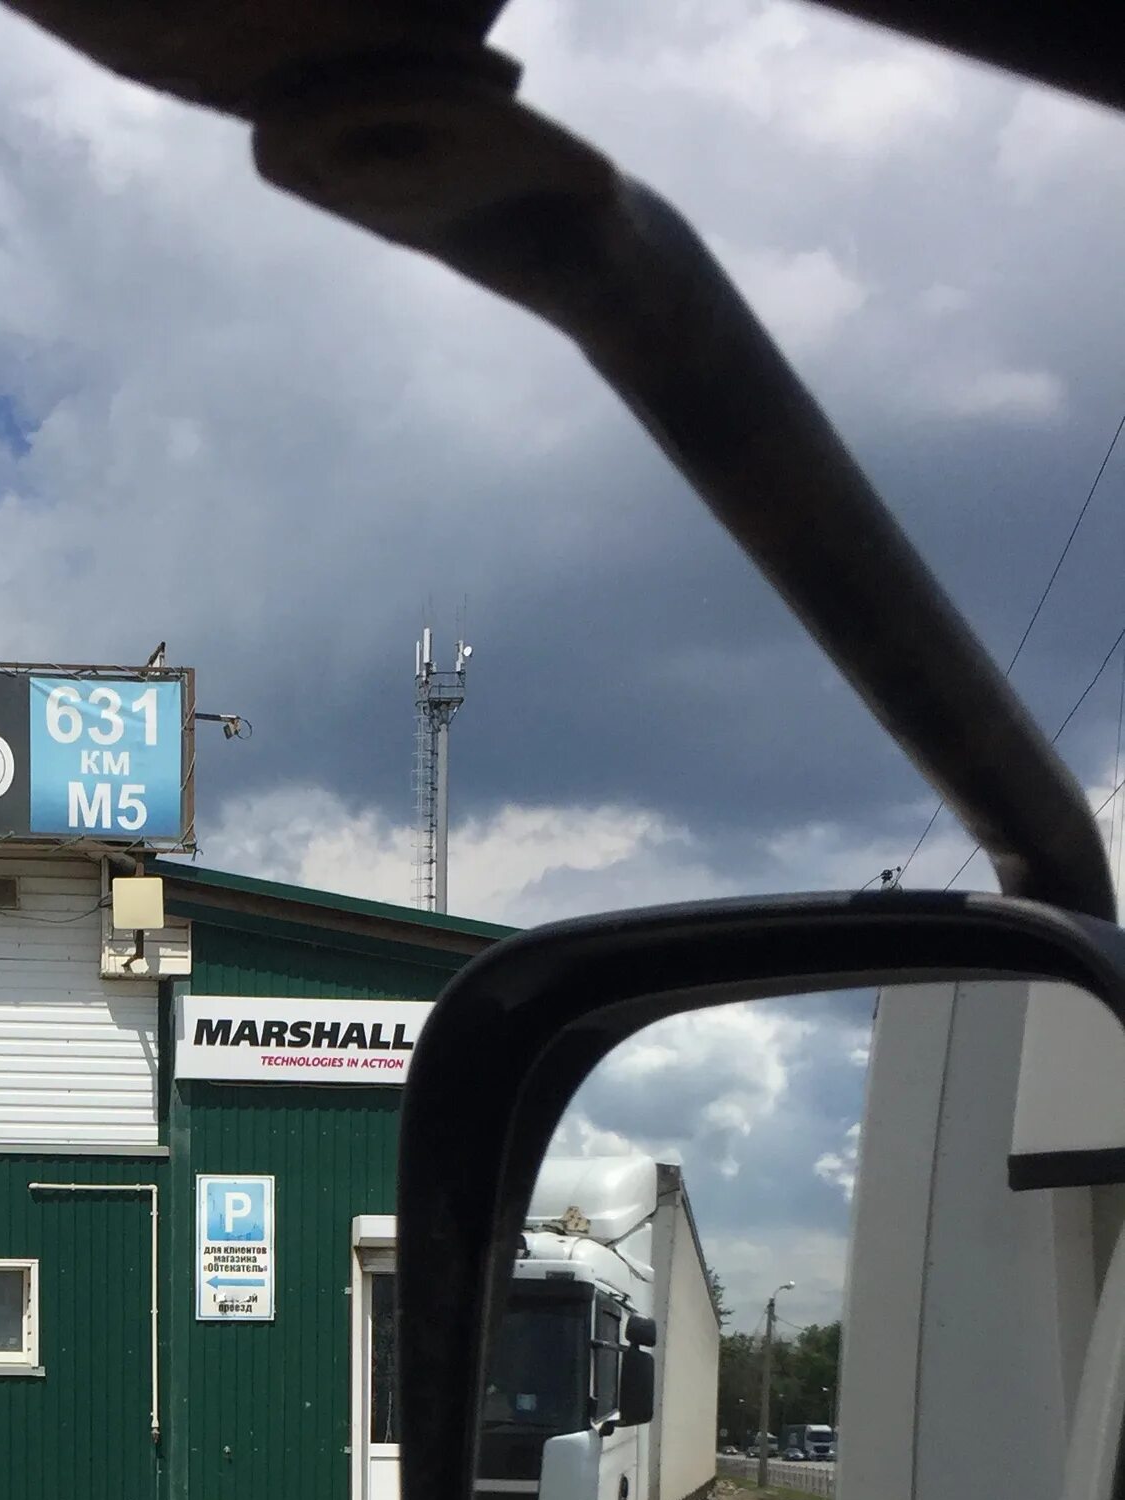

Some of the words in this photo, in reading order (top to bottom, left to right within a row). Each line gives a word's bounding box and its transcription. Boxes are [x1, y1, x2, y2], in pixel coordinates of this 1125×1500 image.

[45, 686, 158, 746] 631
[68, 782, 147, 831] М5
[193, 1019, 415, 1050] MARSHALL
[261, 1055, 344, 1068] TECHNOLOGIES
[347, 1058, 359, 1068] IN
[361, 1058, 404, 1069] ACTION
[204, 1246, 222, 1255] для
[223, 1246, 267, 1255] клиентов
[213, 1255, 257, 1263] магазина
